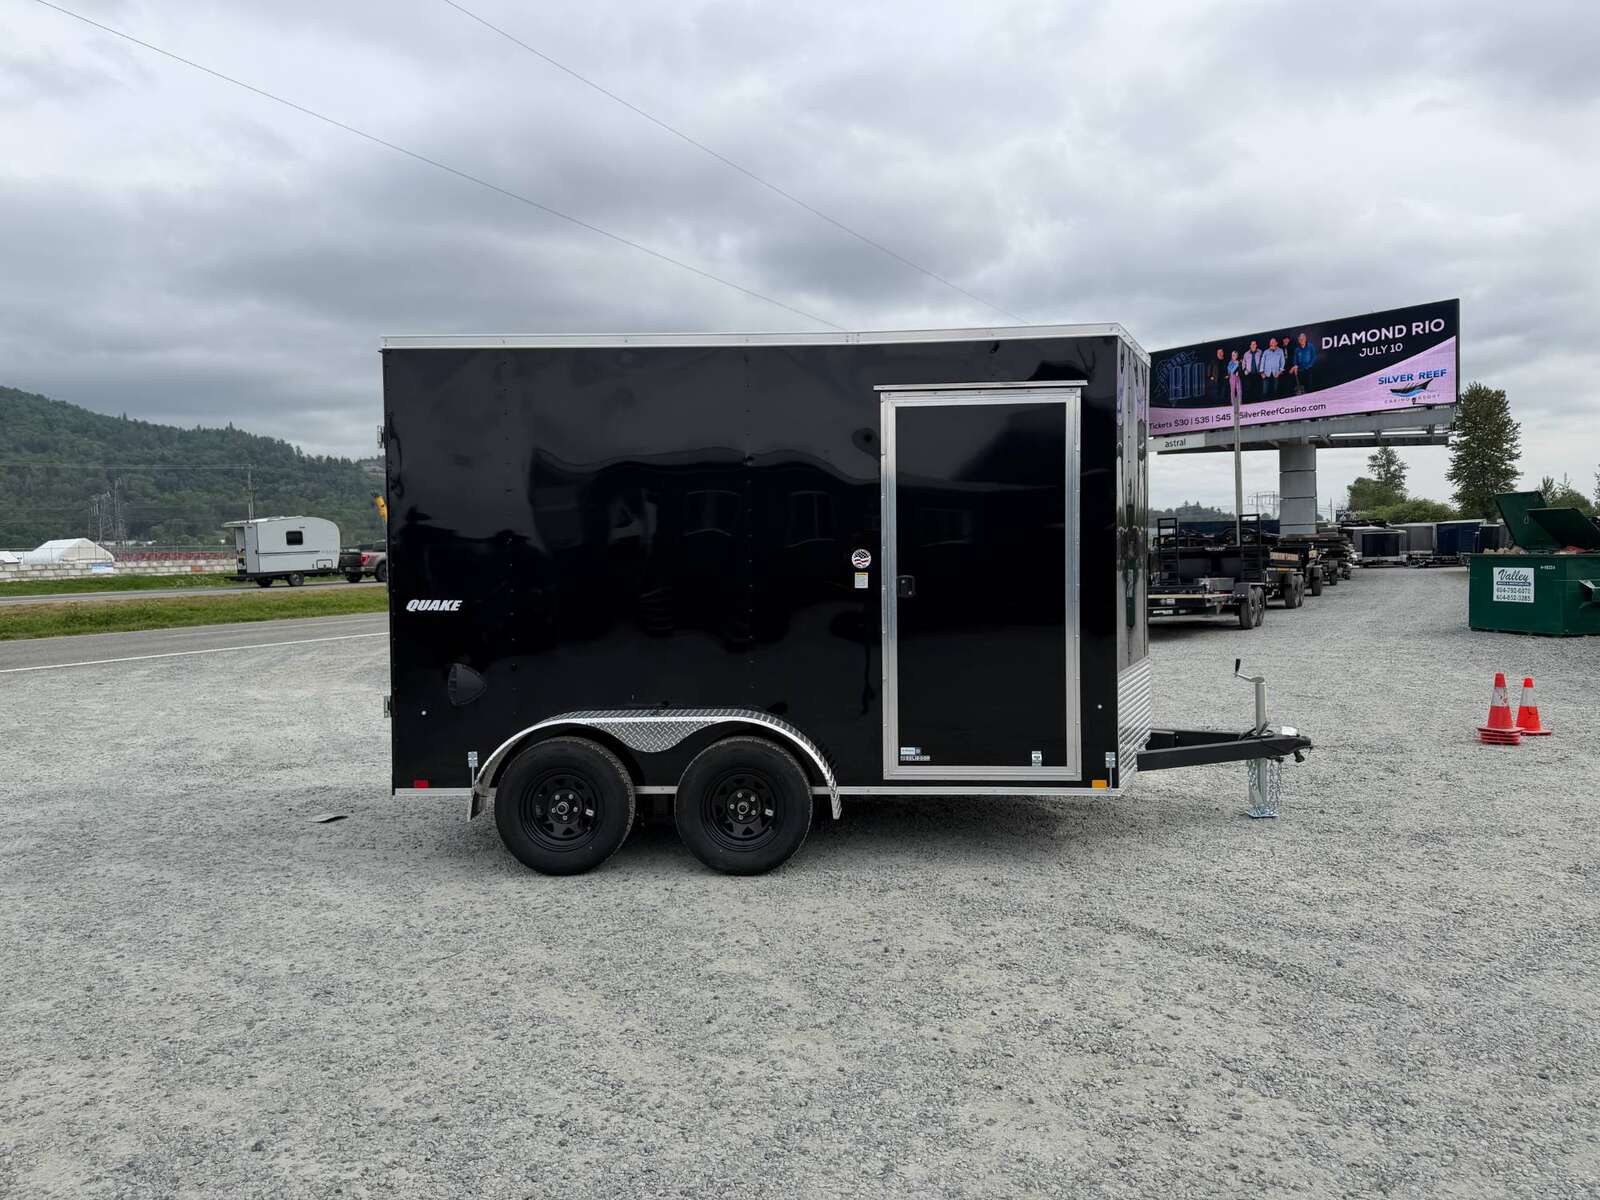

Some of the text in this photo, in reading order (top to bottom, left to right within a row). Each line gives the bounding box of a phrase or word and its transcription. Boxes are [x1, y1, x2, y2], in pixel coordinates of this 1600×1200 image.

[1321, 318, 1445, 350] DIAMOND RIO
[1359, 343, 1403, 357] JULY 10
[1378, 368, 1447, 386] SILVER REEF
[1164, 438, 1186, 448] astral
[1498, 569, 1529, 582] Valley
[406, 599, 463, 612] QUAKE
